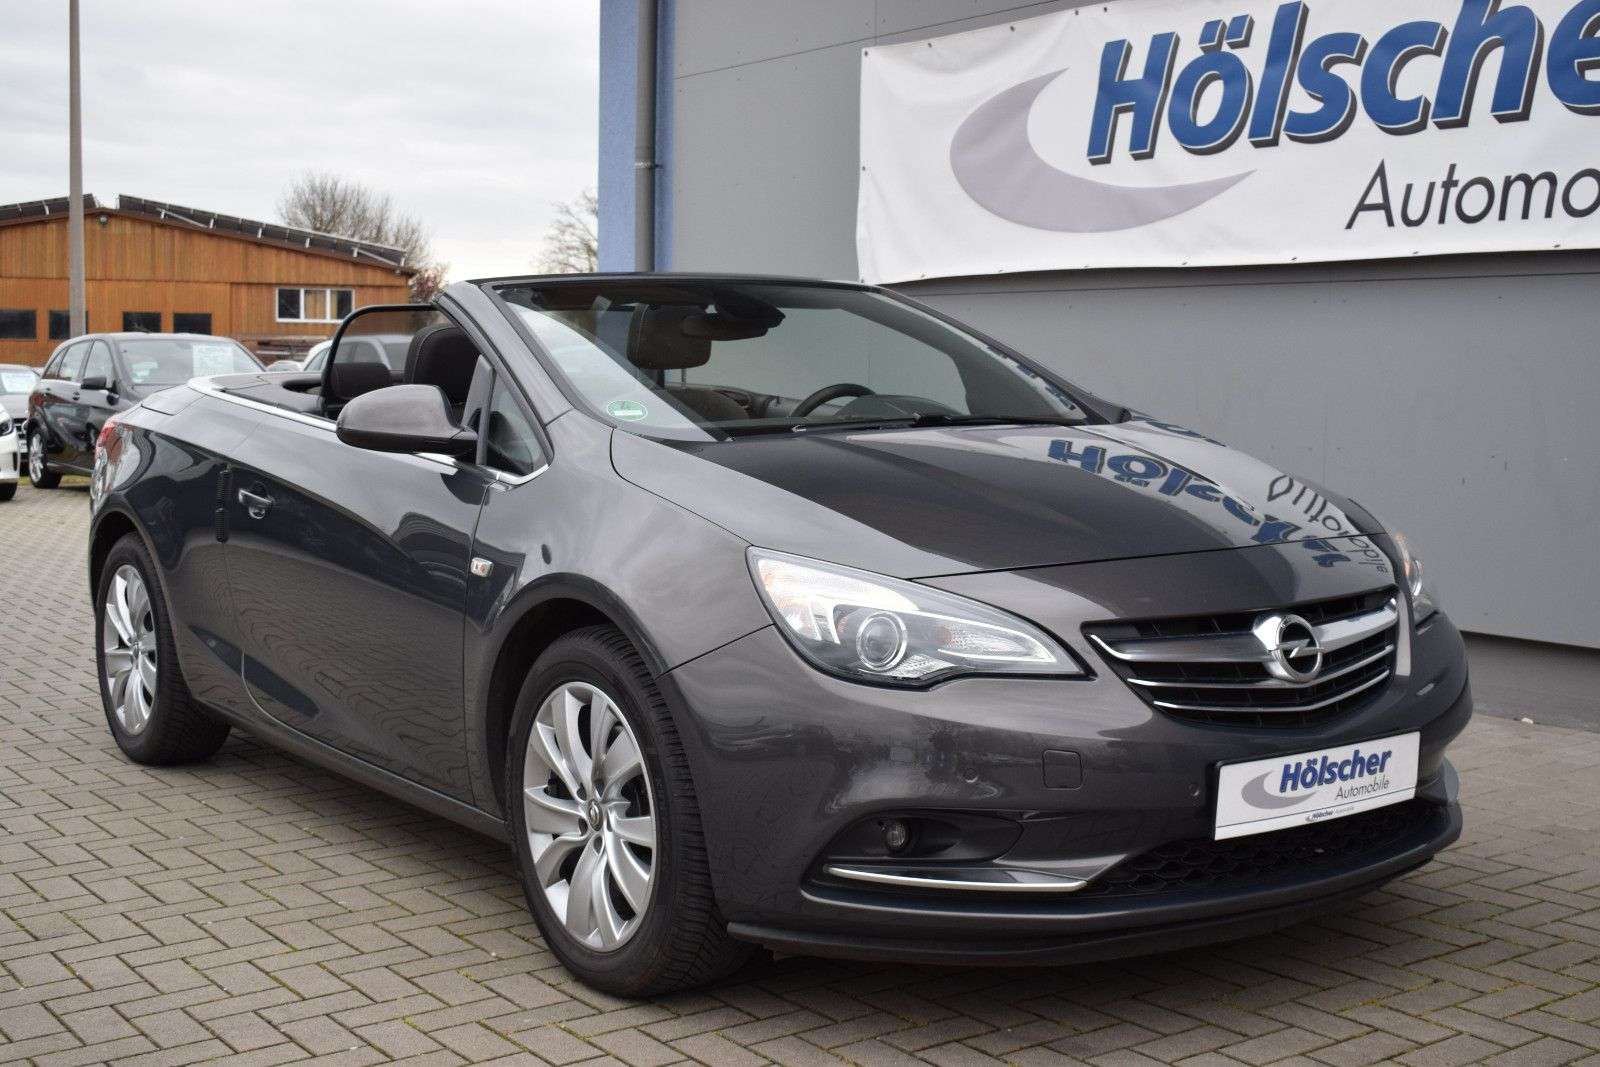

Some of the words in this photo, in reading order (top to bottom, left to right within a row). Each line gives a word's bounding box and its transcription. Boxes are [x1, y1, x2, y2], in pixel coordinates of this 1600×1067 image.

[1344, 159, 1600, 230] Automo
[1279, 750, 1392, 793] Hölscher
[1334, 775, 1390, 800] Automobile
